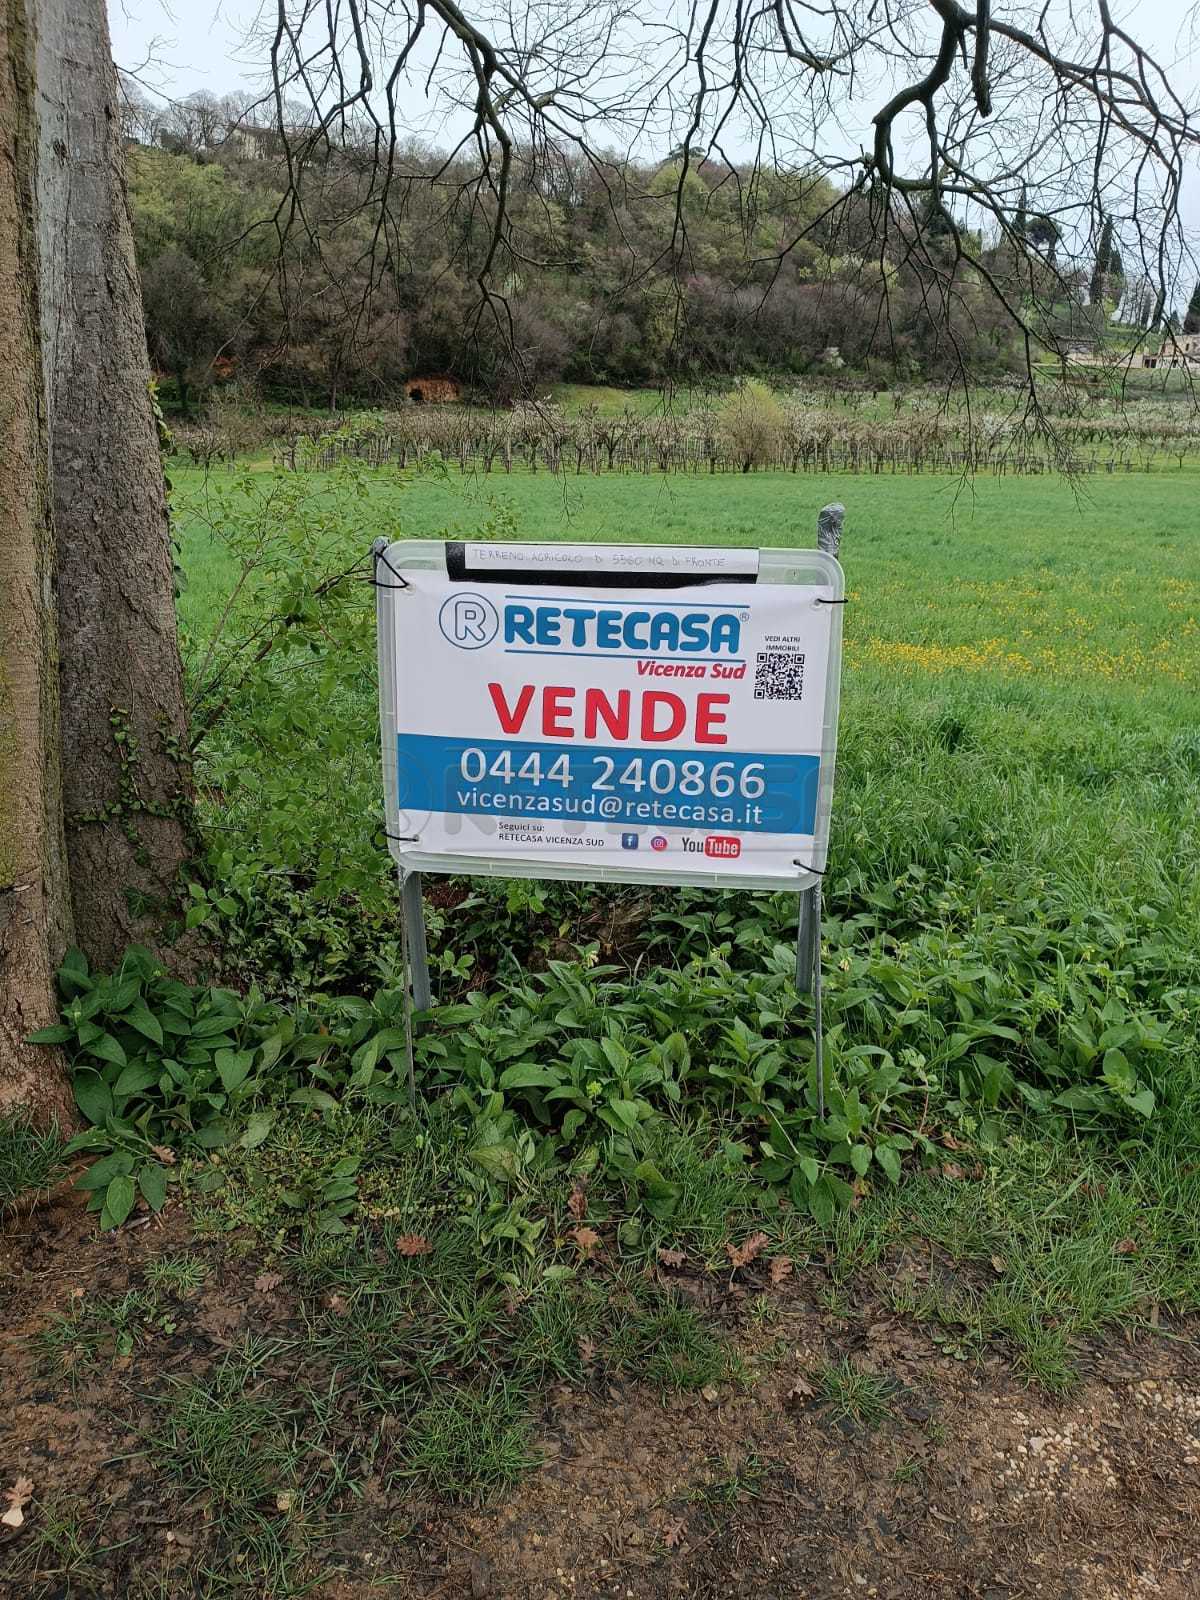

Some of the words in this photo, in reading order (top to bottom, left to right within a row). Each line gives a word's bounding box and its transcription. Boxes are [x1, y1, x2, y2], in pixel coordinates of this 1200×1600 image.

[764, 635, 781, 643] VEDI
[637, 660, 706, 679] Vicenza
[710, 664, 747, 680] Sud
[488, 683, 731, 745] VENDE
[460, 747, 573, 790] 0444
[592, 755, 766, 799] 240866
[457, 787, 763, 824] vicenzasud@retecasa.it
[498, 821, 531, 833] Seguici
[534, 824, 545, 832] su:
[498, 832, 543, 843] RETECASA
[545, 836, 583, 846] VICENZA
[586, 838, 605, 847] SUD
